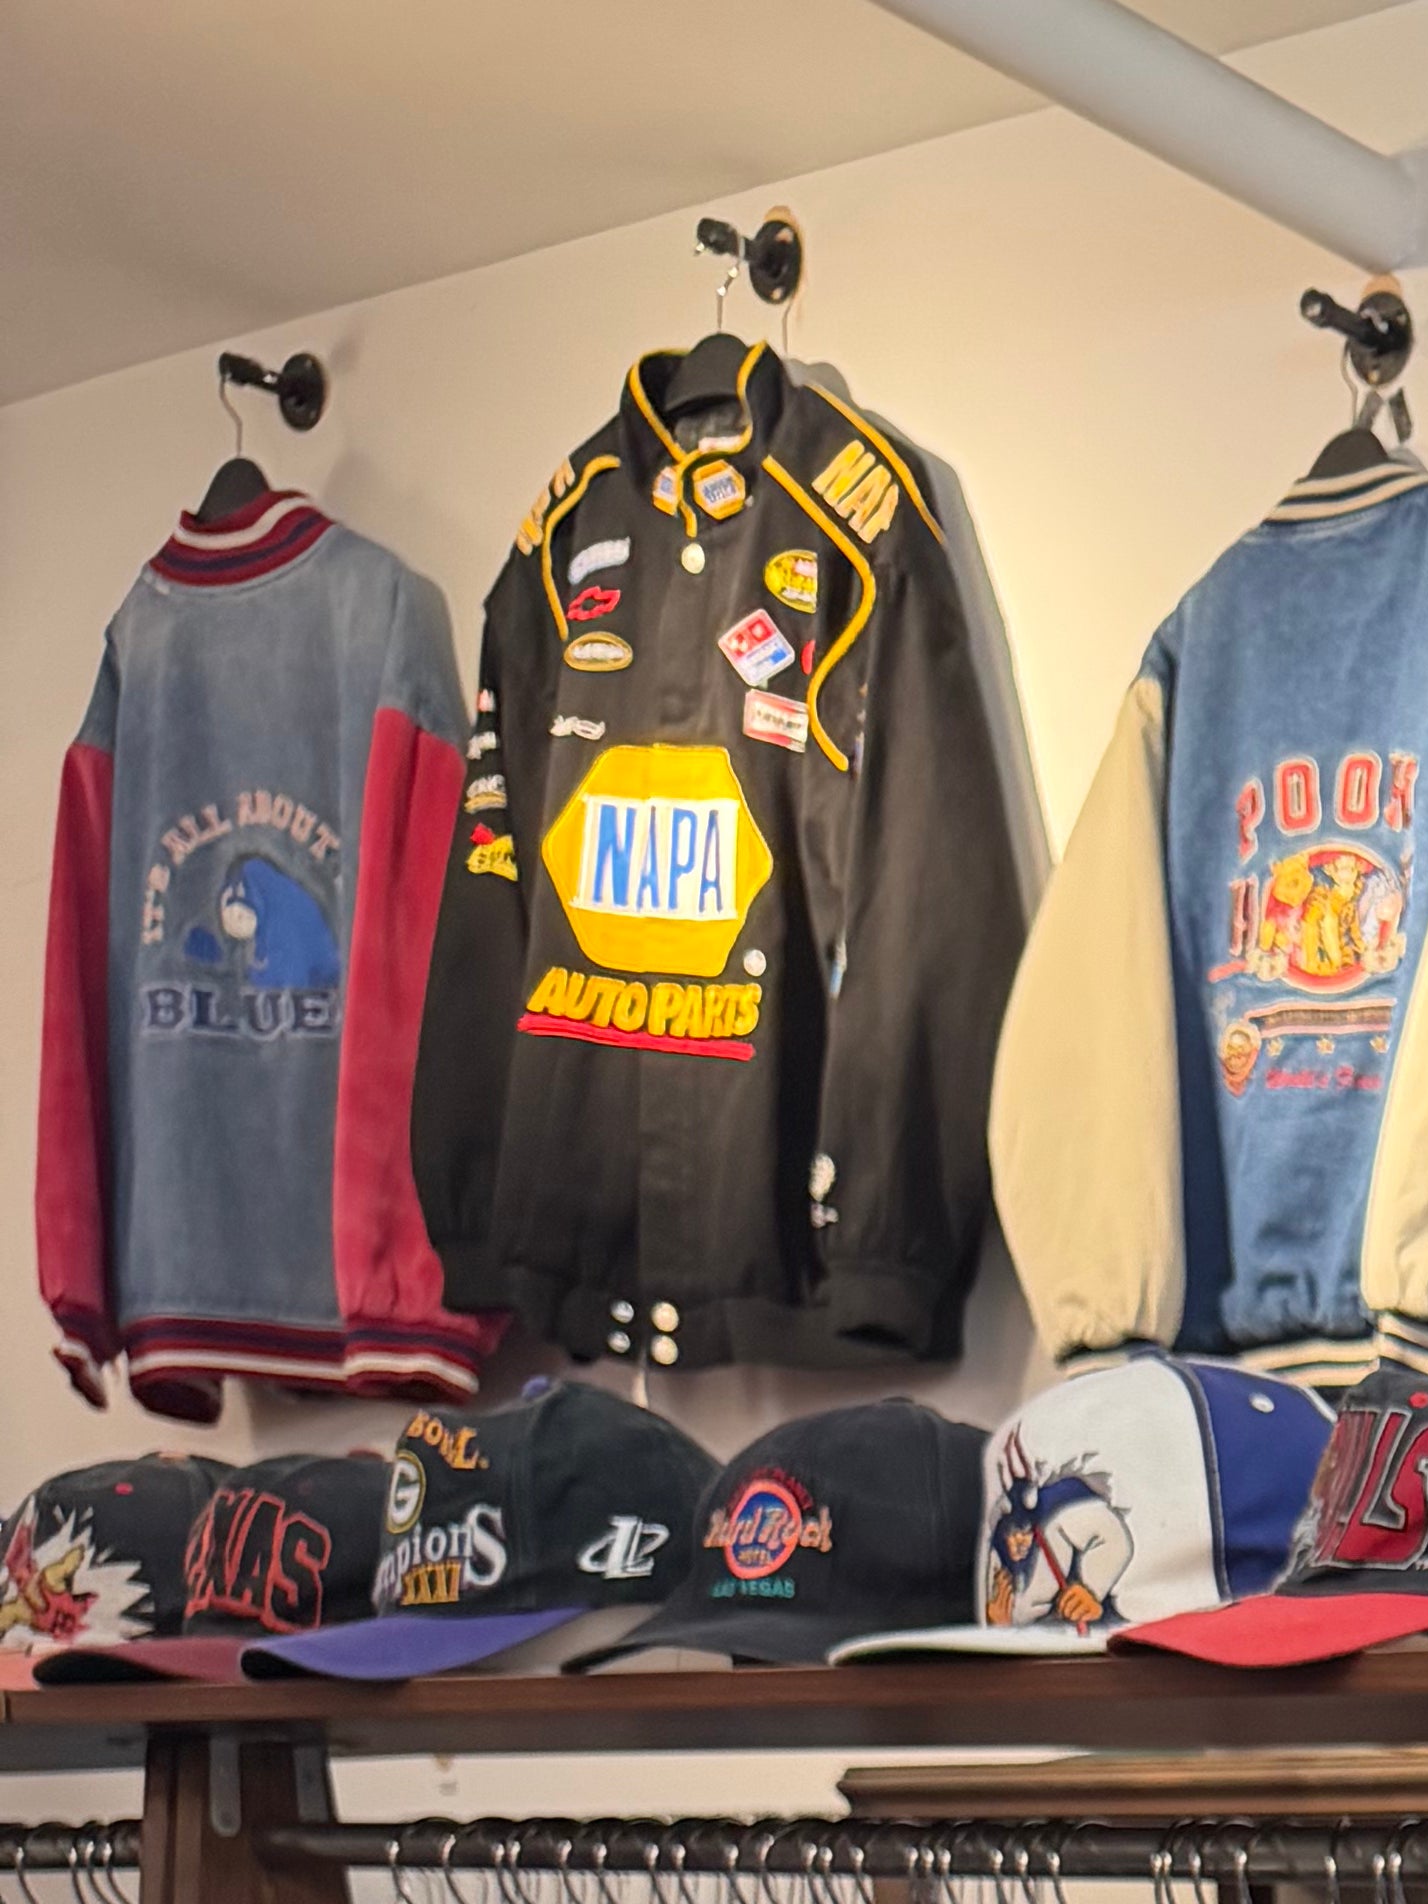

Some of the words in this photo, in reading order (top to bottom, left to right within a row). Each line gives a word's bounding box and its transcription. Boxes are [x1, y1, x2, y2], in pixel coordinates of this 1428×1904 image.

[592, 802, 725, 914] NAPA
[141, 981, 343, 1042] BLUE
[526, 966, 649, 1033] AUTO
[647, 981, 763, 1039] PARTS
